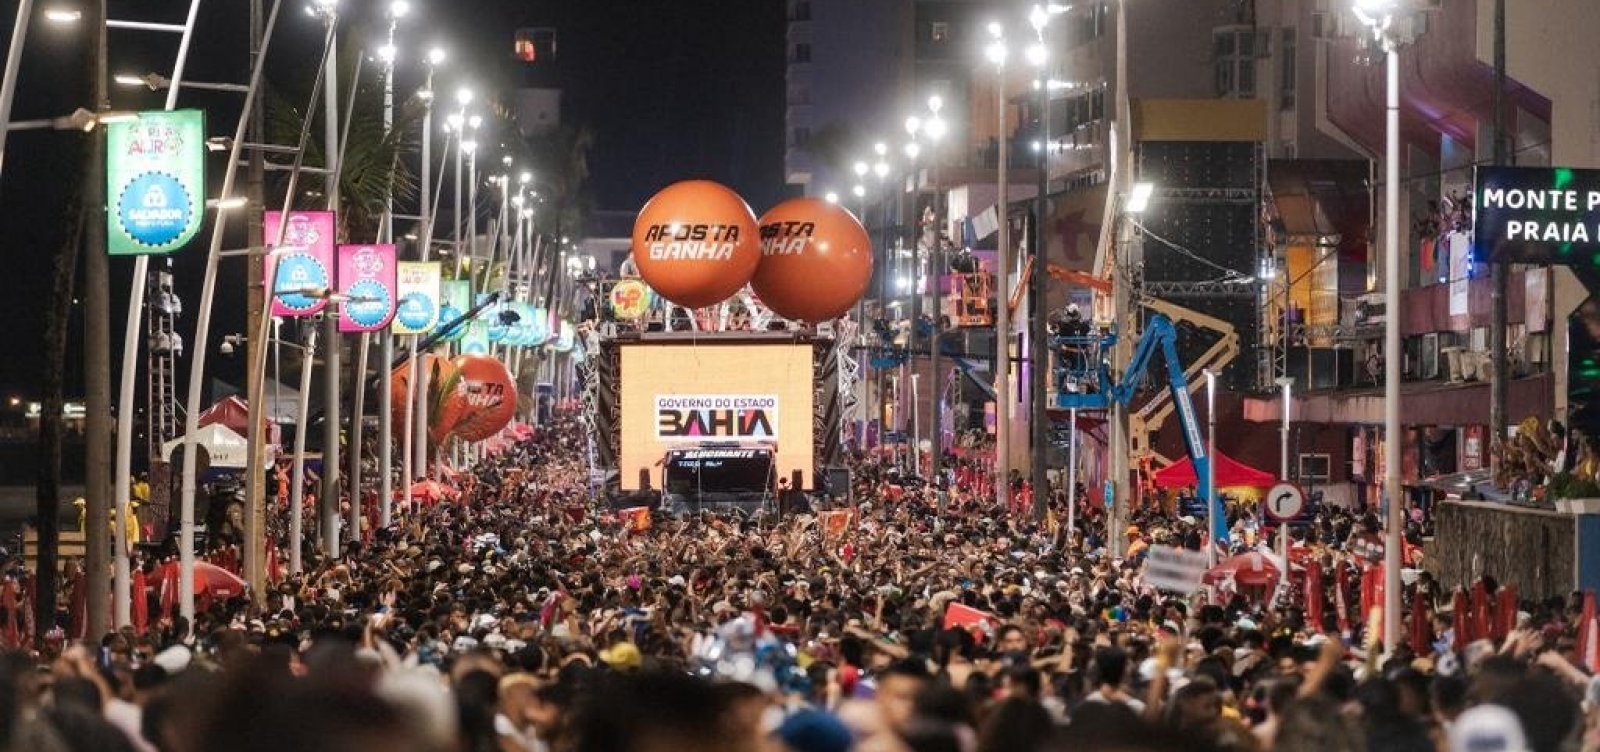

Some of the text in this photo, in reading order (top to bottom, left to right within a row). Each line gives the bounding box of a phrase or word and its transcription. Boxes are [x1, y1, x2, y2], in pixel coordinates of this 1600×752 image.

[1484, 188, 1578, 211] MONTE
[1507, 221, 1590, 243] PRAIA
[650, 241, 735, 261] GANHA
[659, 398, 775, 408] GOVERNO DO ESTADO
[659, 409, 774, 436] BAHIA
